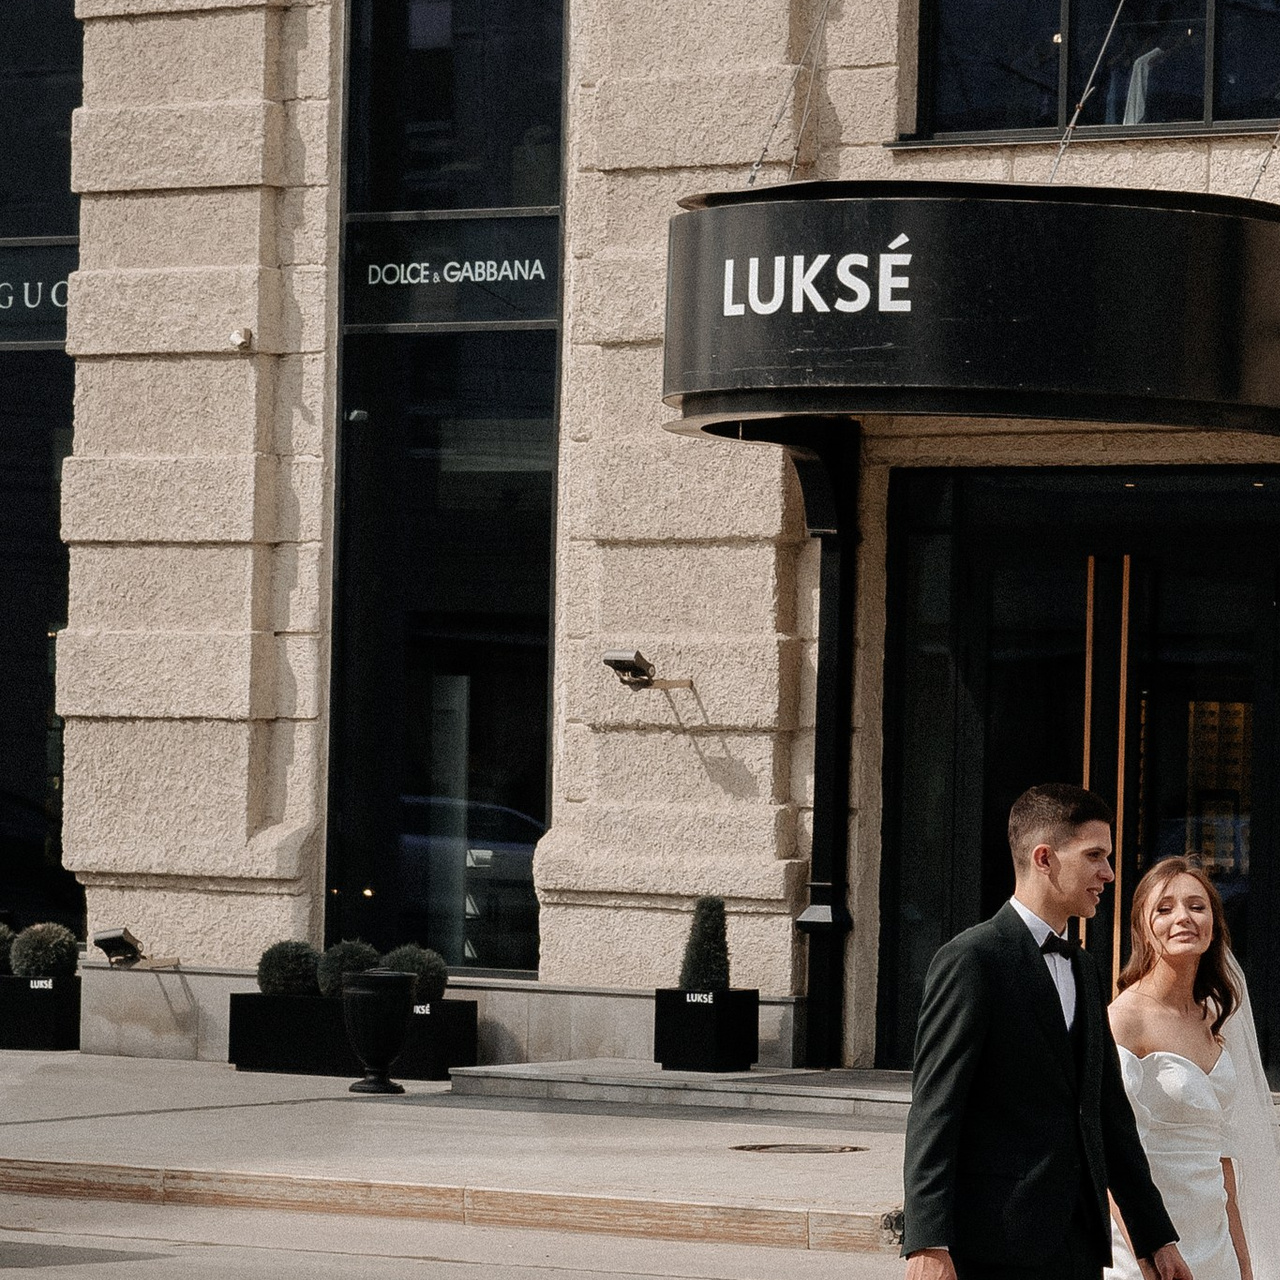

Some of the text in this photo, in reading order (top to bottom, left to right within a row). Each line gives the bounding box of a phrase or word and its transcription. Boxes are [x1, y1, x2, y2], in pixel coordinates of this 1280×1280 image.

[368, 263, 430, 285] DOLCE
[443, 259, 546, 283] GABBANA
[723, 232, 913, 317] LUKSÉ
[686, 991, 714, 1004] LUKSÉ
